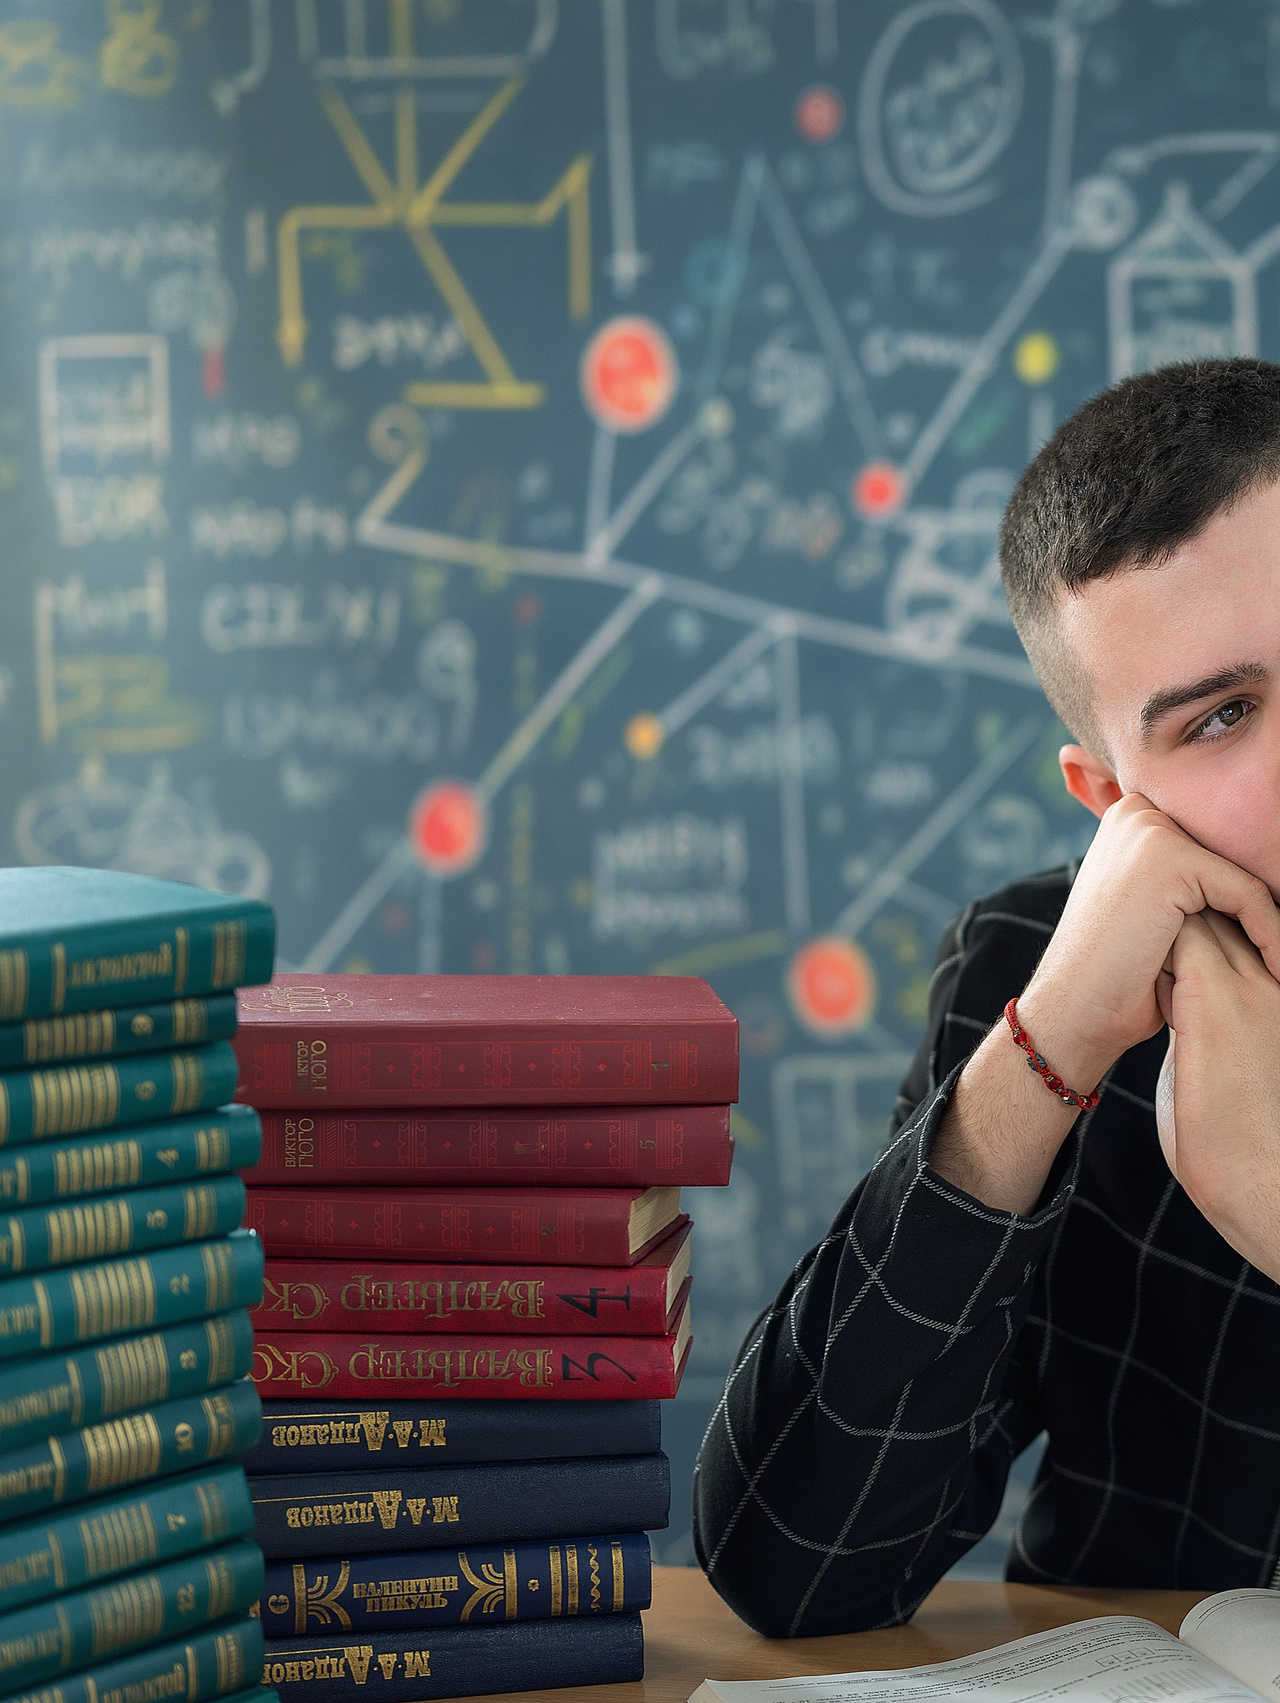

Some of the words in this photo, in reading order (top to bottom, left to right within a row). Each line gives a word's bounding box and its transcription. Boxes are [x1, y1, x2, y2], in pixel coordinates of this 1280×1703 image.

[311, 1040, 327, 1091] ГЮГО
[651, 1061, 670, 1072] 1
[284, 1118, 296, 1168] ВИКТОР
[299, 1118, 314, 1168] ГЮГО
[639, 1138, 657, 1150] 5
[156, 1148, 179, 1168] 4
[540, 1225, 556, 1236] 2
[555, 1284, 631, 1319] 4
[562, 1348, 637, 1384] 3
[166, 1513, 187, 1532] 7
[353, 1575, 460, 1599] ВАЛЕНТИН
[365, 1592, 449, 1613] ПИКУЛЬ
